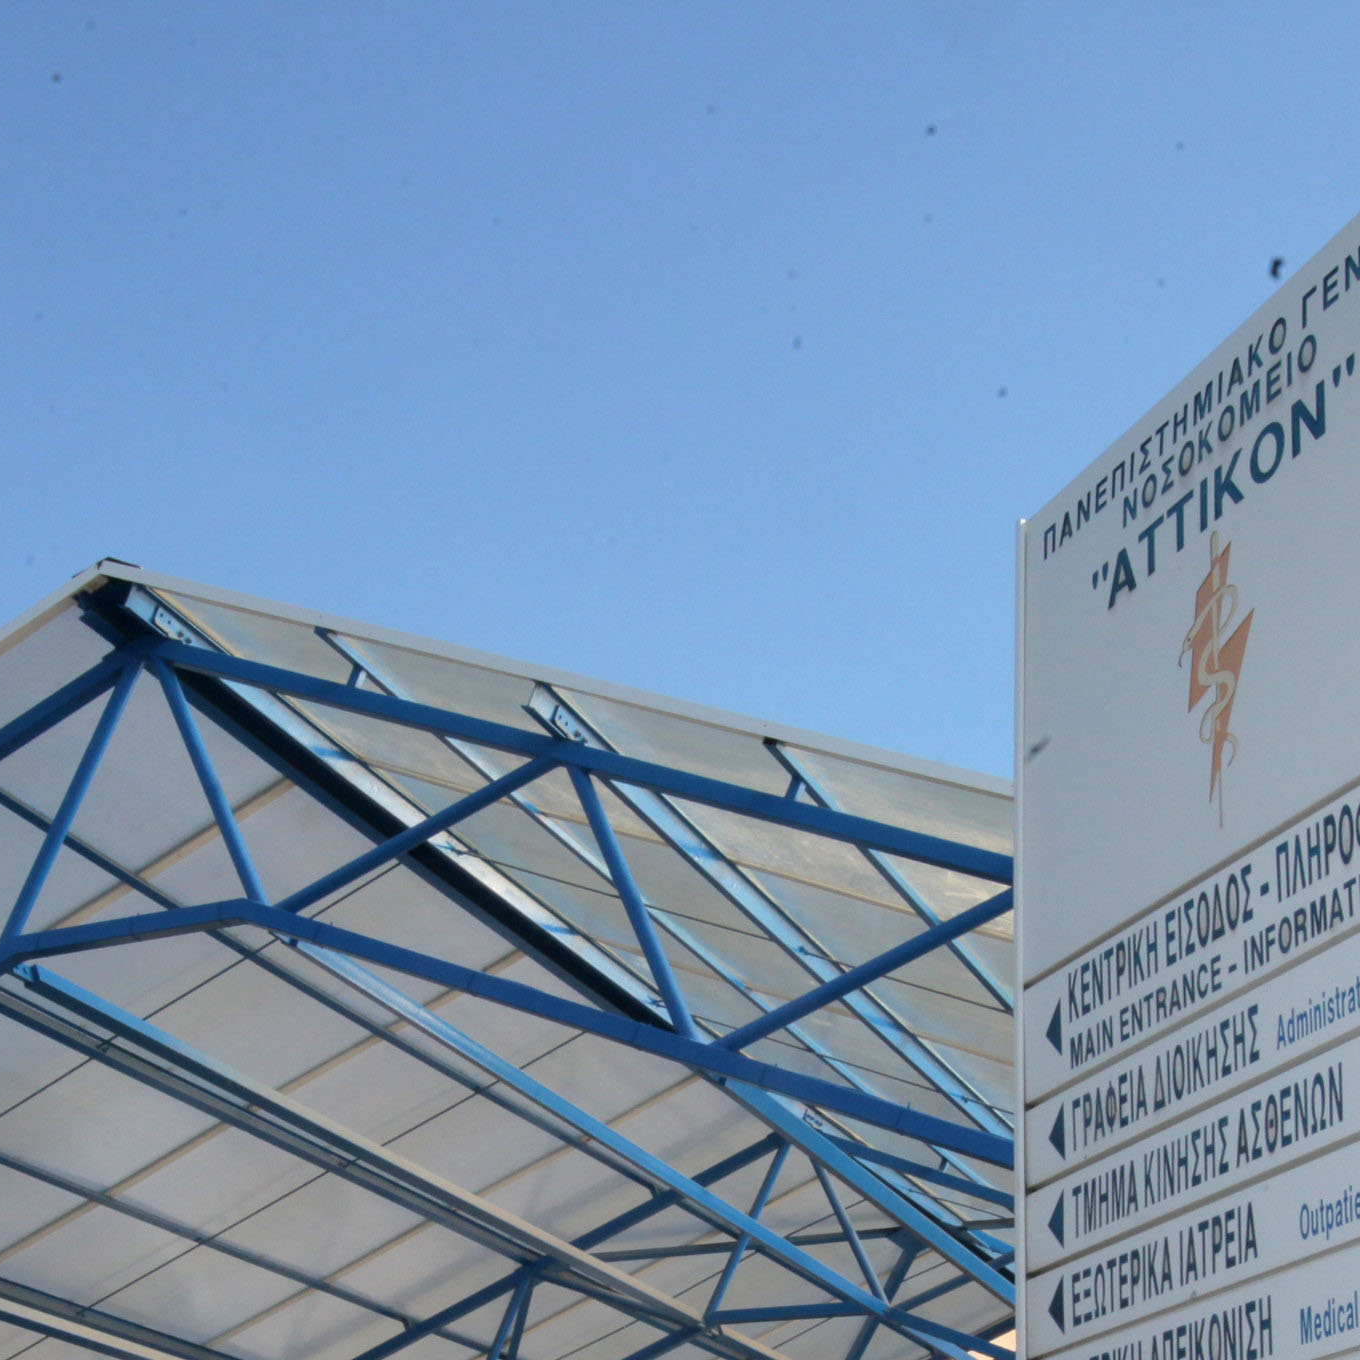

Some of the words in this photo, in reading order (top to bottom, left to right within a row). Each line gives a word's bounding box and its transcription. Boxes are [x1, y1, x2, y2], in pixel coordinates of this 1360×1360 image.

[1043, 316, 1288, 561] ΠΑΝΕΠΙΣΤΗΜΙΑΚΟ
[1122, 333, 1318, 528] ΝΟΣΟΚΟΜΕΙΟ
[1067, 920, 1159, 1024] ΚΕΝΤΡΙΚΗ
[1165, 864, 1254, 967] ΕΙΣΟΔΟΣ
[1260, 881, 1270, 896] -
[1069, 1022, 1114, 1069] MAIN
[1119, 954, 1223, 1042] ENTRANCE
[1228, 963, 1238, 974] -
[1071, 1064, 1149, 1152] ΓΡΑΦΕΙΑ
[1153, 1004, 1261, 1112] ΔΙΟΙΚΗΣΗΣ
[1072, 1160, 1139, 1238] ΤΜΗΜΑ
[1143, 1115, 1230, 1208] ΚΙΝΗΣΗΣ
[1237, 1062, 1344, 1168] ΑΣΘΕΝΩΝ
[1071, 1236, 1173, 1328] ΕΞΩΤΕΡΙΚΑ
[1179, 1201, 1259, 1286] ΙΑΤΡΕΙΑ
[1300, 1297, 1359, 1345] Medical
